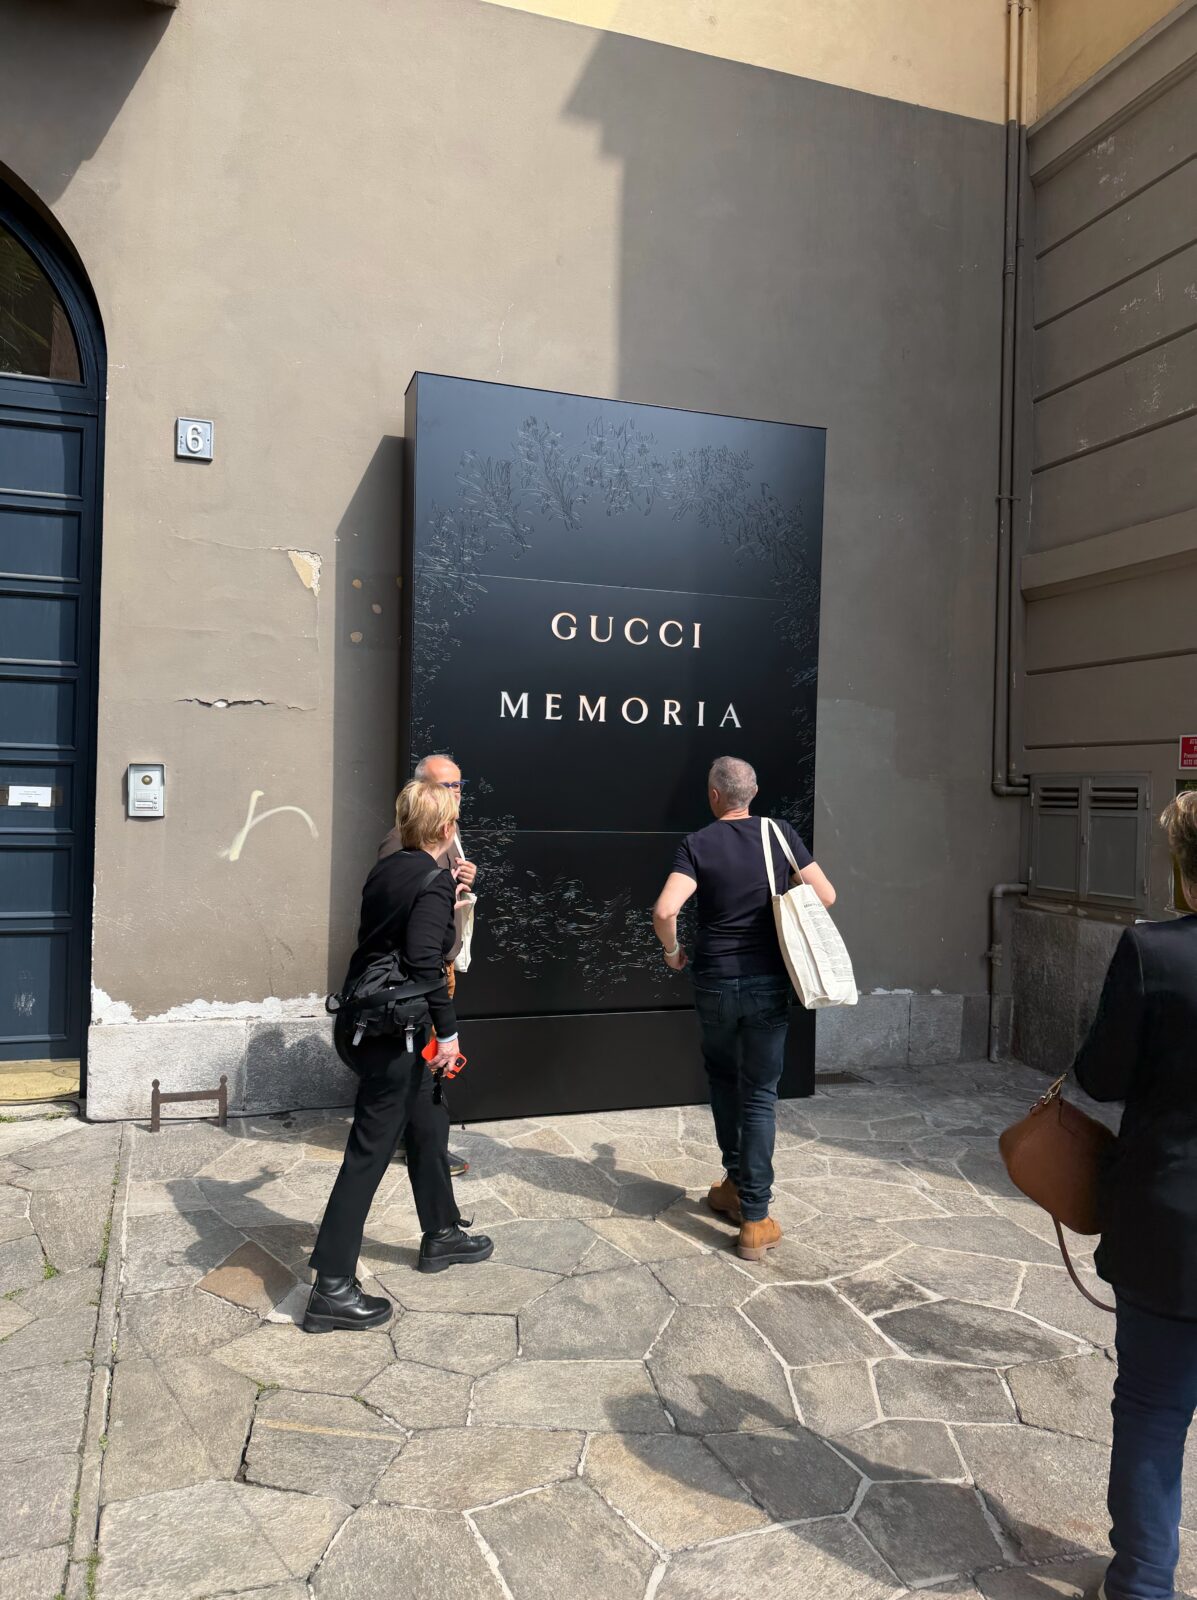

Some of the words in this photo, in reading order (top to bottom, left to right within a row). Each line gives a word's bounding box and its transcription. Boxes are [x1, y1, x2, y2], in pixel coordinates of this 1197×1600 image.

[187, 424, 203, 451] 6
[551, 612, 701, 648] GUCCI
[500, 691, 742, 728] MEMORIA
